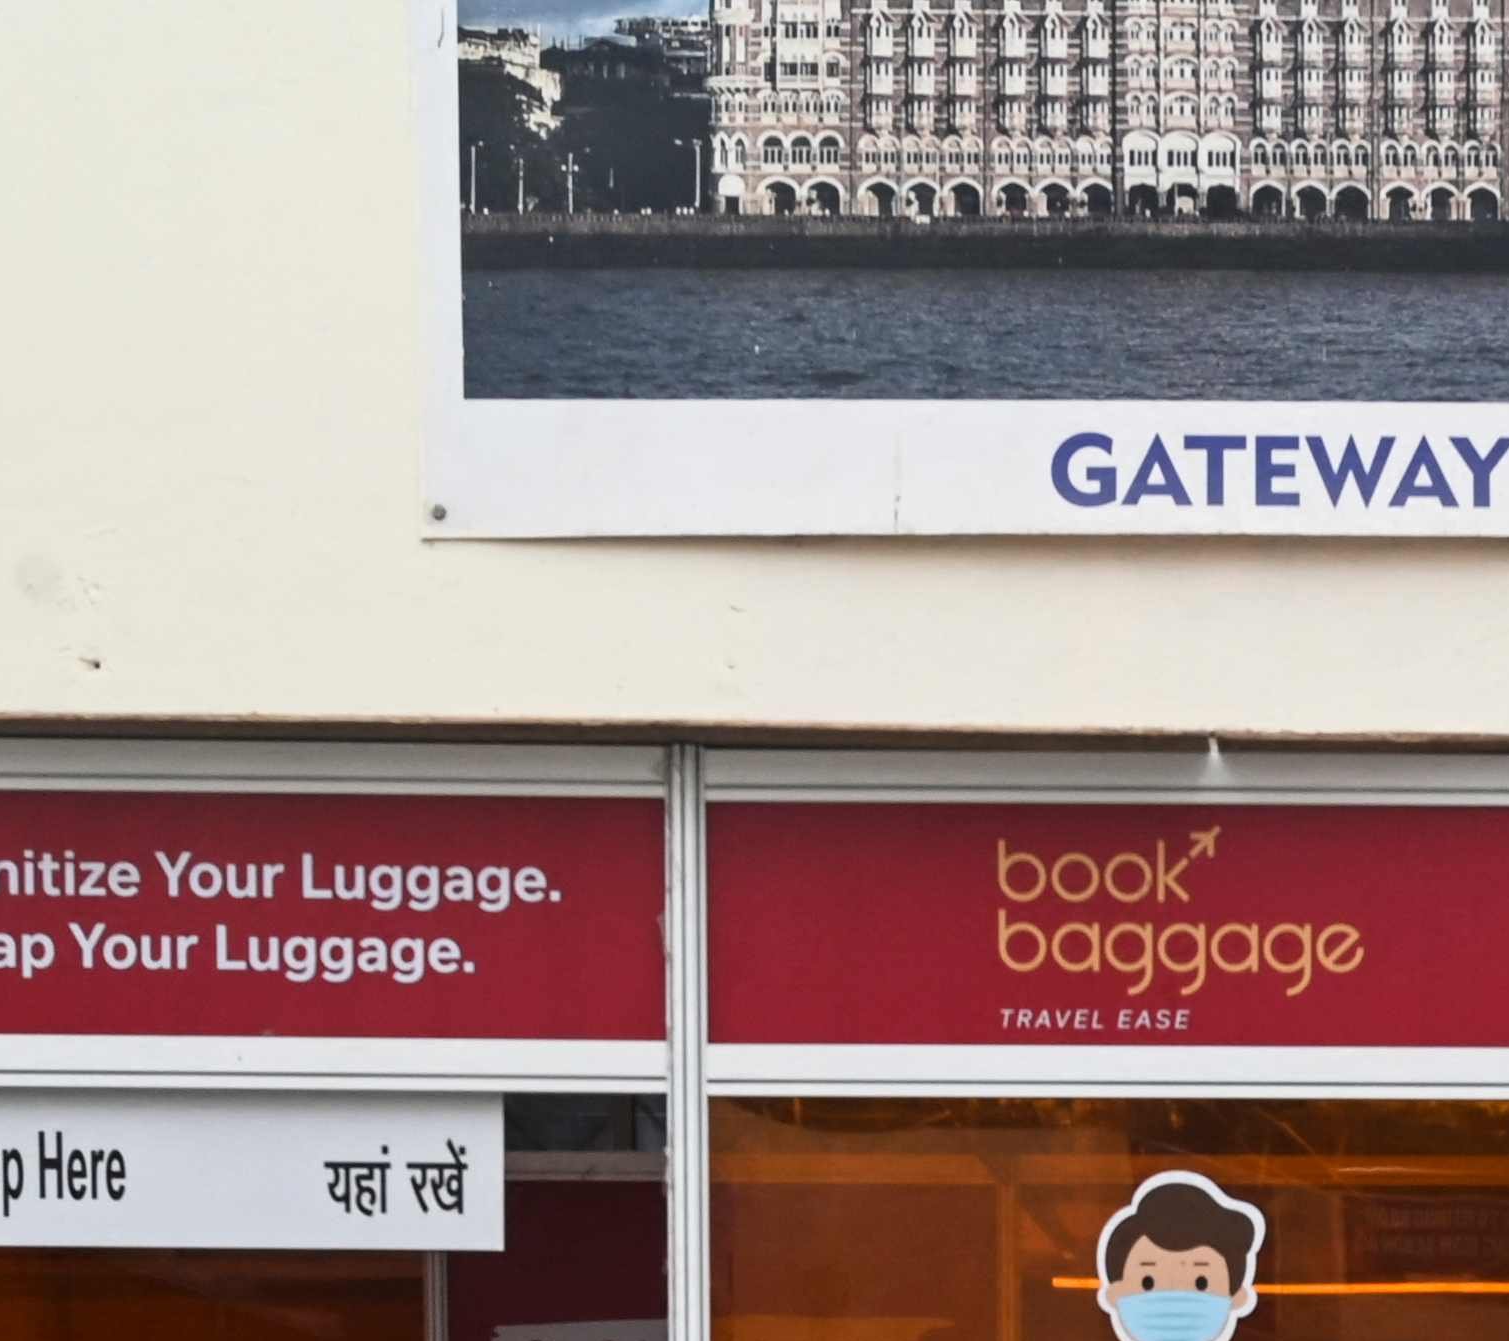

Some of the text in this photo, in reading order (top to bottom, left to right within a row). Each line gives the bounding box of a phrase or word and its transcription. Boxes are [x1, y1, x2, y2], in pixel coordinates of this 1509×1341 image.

[156, 851, 285, 903] Your
[299, 854, 563, 913] Luggage.
[997, 837, 1191, 904] book
[70, 923, 200, 974] Your
[214, 925, 477, 984] Luggage.
[997, 908, 1365, 997] baggage
[999, 1007, 1192, 1031] TRAVEL EASE
[37, 1130, 128, 1202] Here
[324, 1138, 471, 1216] यहां रखें
